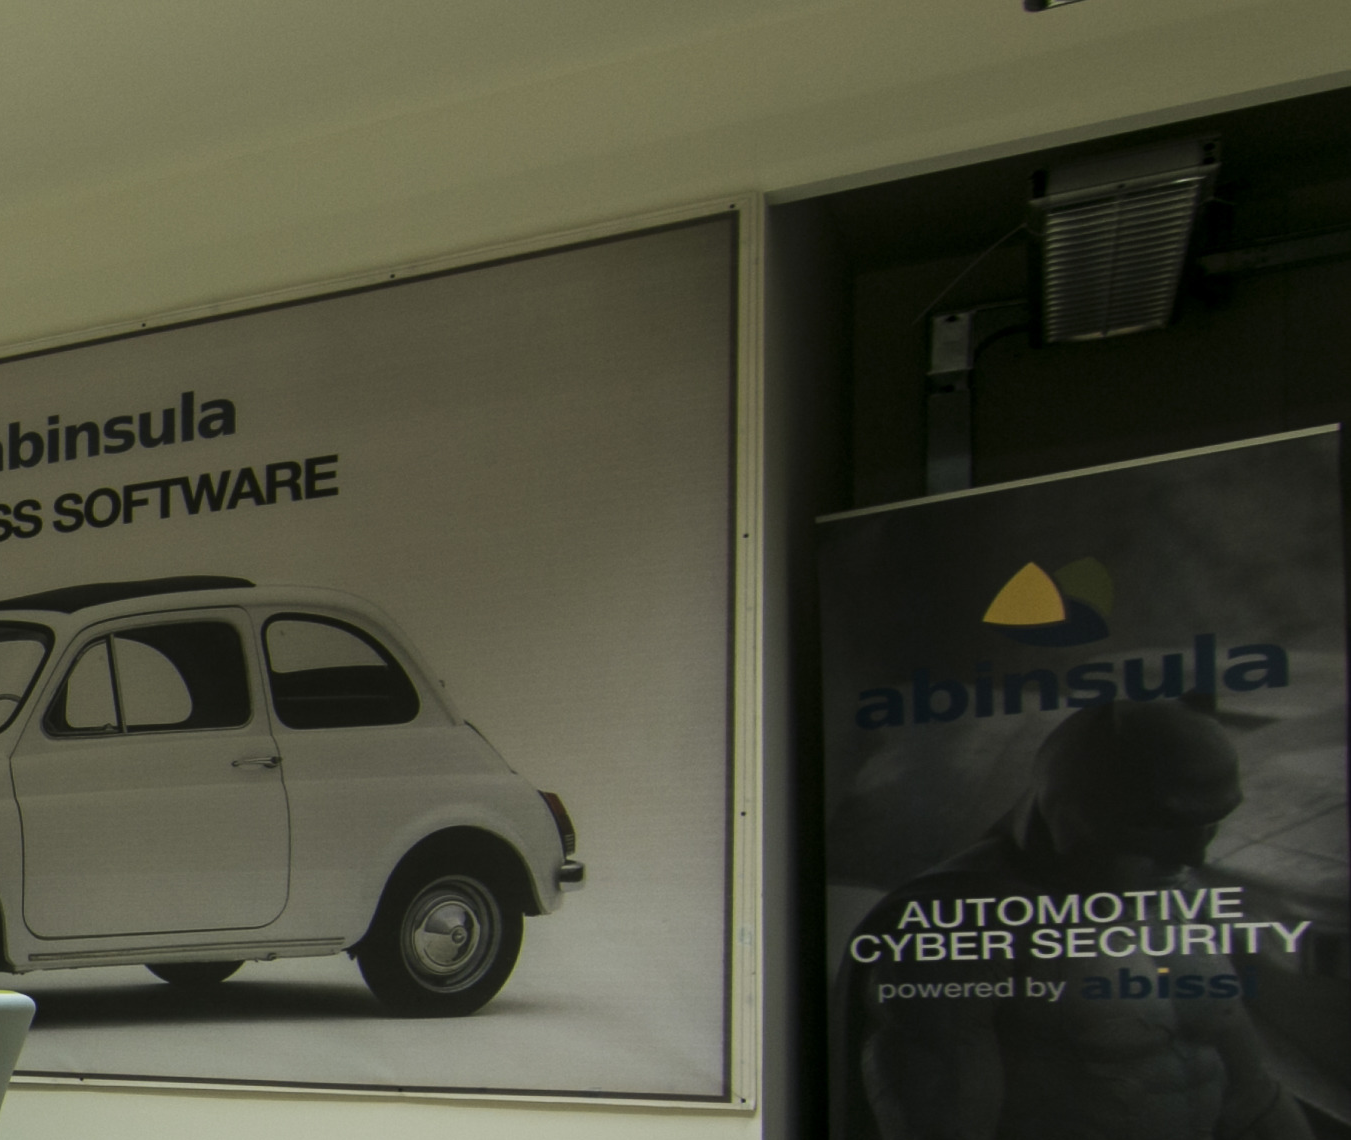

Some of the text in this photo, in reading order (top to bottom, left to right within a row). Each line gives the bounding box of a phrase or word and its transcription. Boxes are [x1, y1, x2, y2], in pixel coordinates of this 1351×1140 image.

[53, 454, 339, 533] SOFTWARE
[855, 633, 1290, 731] abinsula
[897, 887, 1244, 930] AUTOMOTIVE
[850, 921, 1312, 963] CYBER SECURITY
[878, 965, 1259, 1003] powered by abissi
